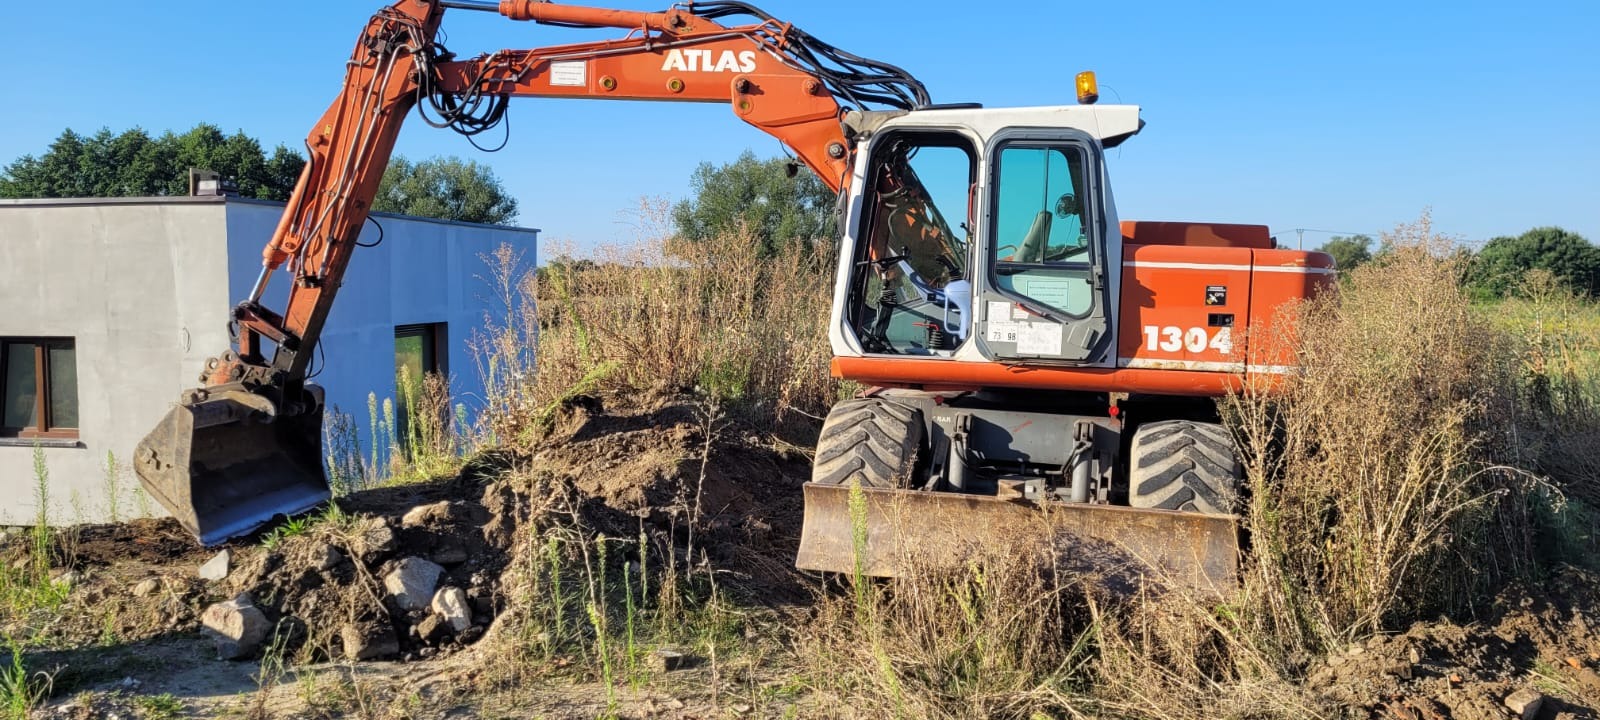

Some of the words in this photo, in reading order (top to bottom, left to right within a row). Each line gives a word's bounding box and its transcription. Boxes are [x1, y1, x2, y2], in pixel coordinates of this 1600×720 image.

[661, 49, 756, 73] ATLAS
[1007, 332, 1017, 341] 98
[1144, 325, 1233, 354] 1304
